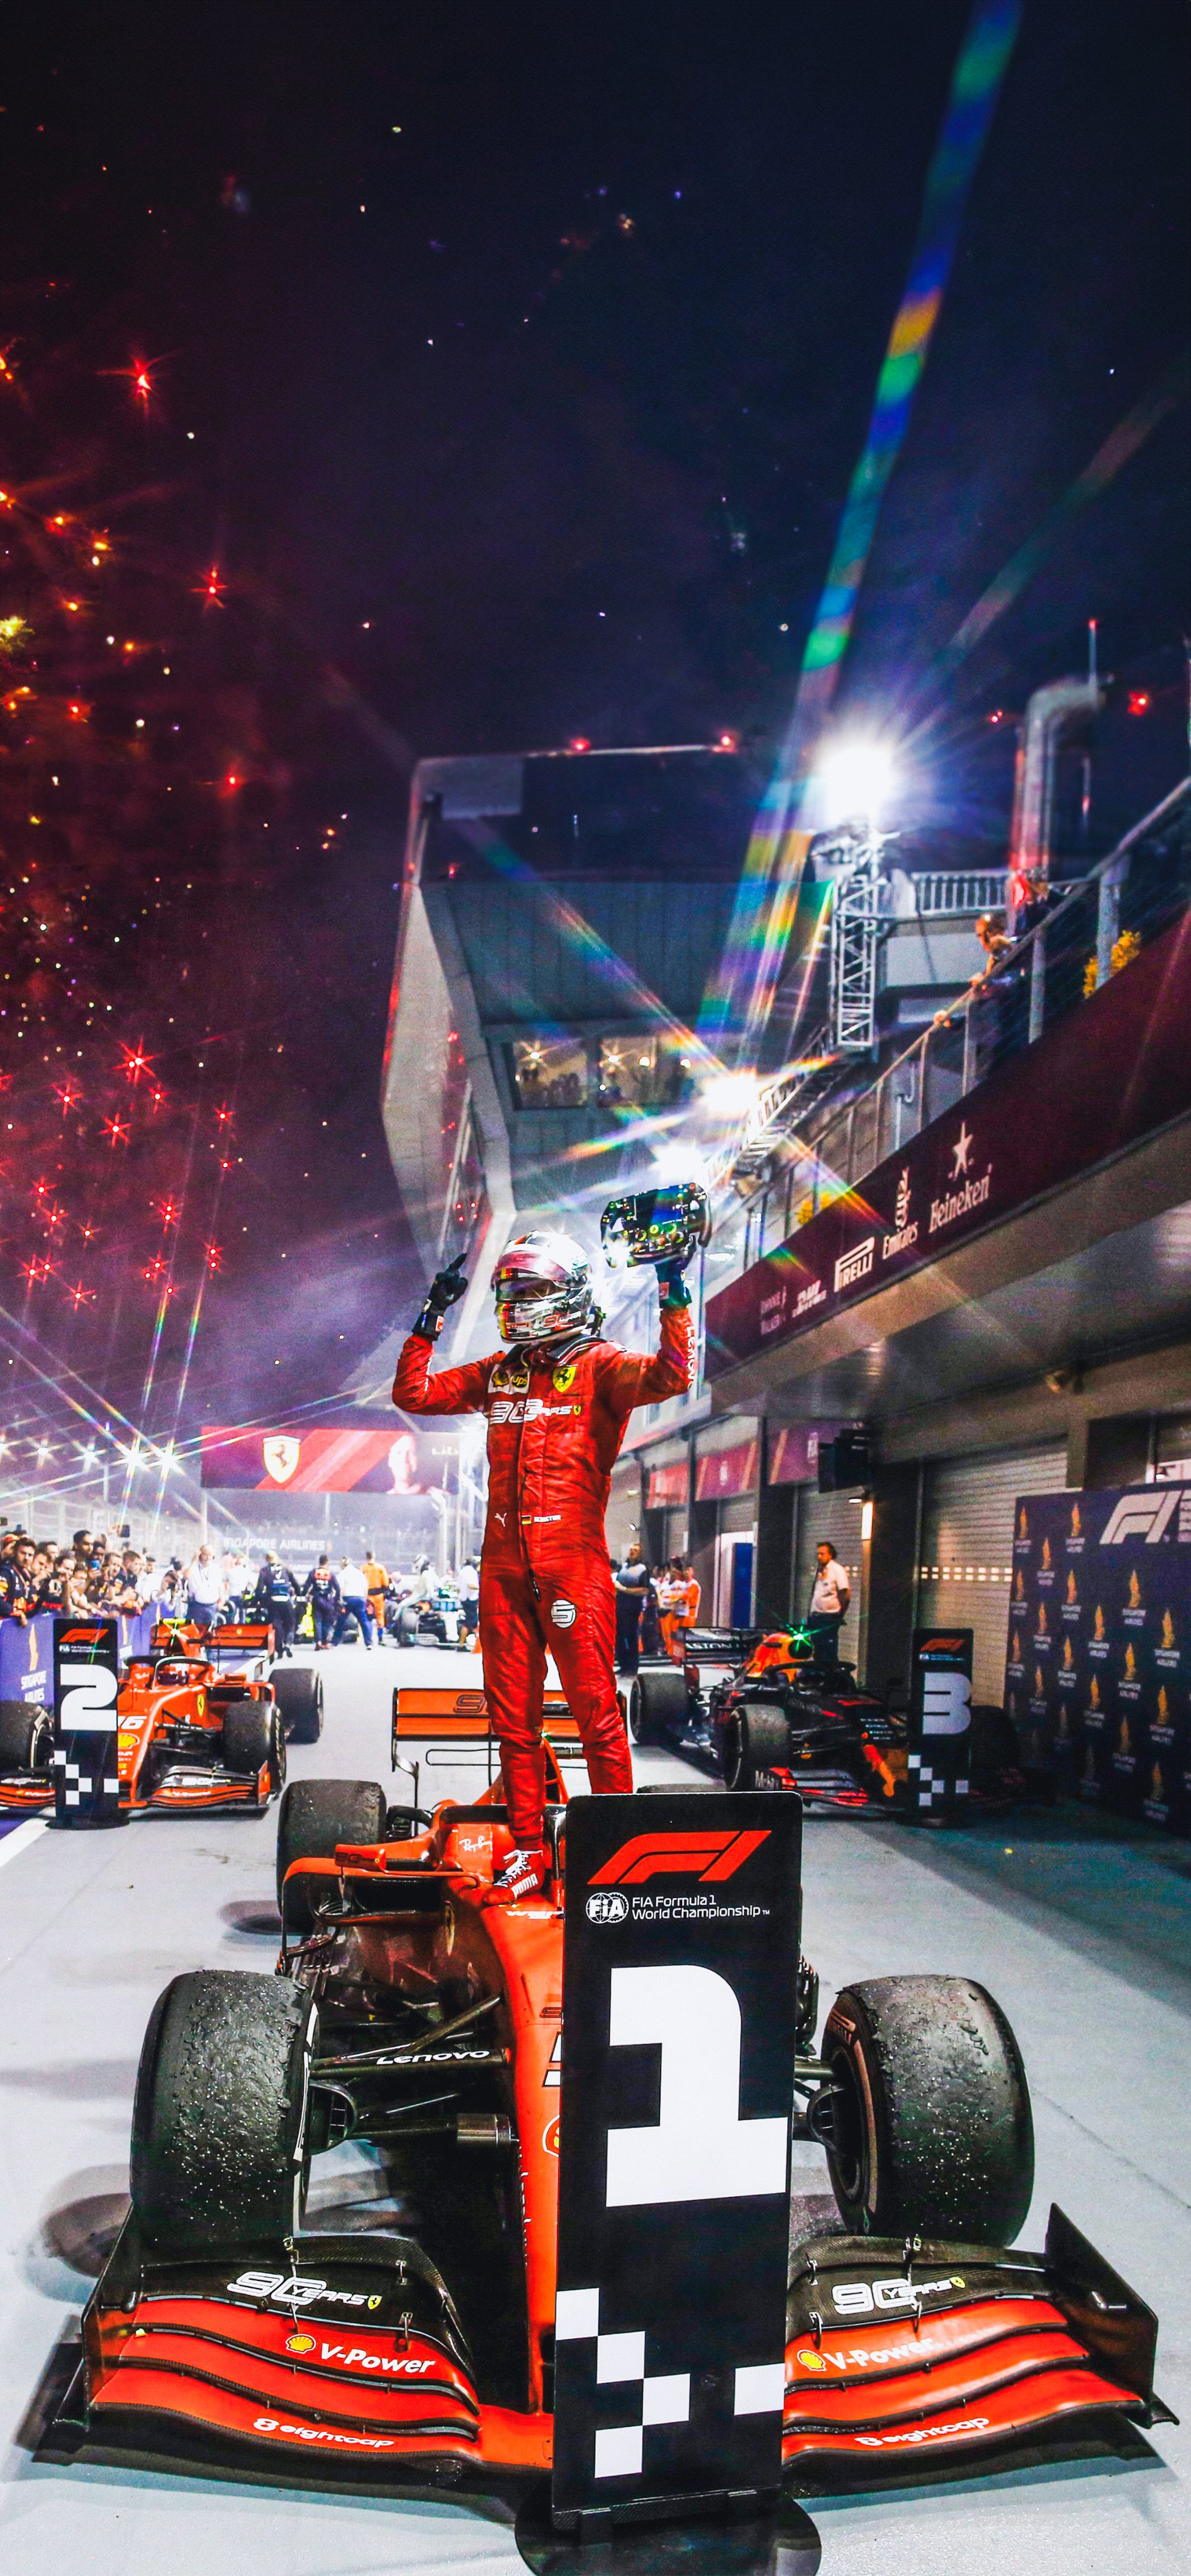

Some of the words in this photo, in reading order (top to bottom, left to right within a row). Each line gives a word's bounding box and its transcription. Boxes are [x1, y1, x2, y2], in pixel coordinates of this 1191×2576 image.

[928, 1175, 990, 1233] Heineken
[834, 1236, 875, 1293] PIRELLI
[552, 1604, 575, 1623] 5
[59, 1628, 109, 1643] F1
[60, 1663, 118, 1731] 2
[922, 1672, 972, 1735] 3
[587, 1829, 773, 1885] F1
[632, 1896, 654, 1908] FIA
[656, 1896, 707, 1907] Formula
[708, 1895, 717, 1906] 1
[632, 1907, 670, 1920] World
[672, 1906, 761, 1919] Championship
[376, 2050, 490, 2065] Lenovo
[605, 1964, 788, 2207] 1
[291, 2285, 369, 2306] YEARS
[883, 2279, 953, 2300] YEARS
[321, 2343, 436, 2373] V-Power
[822, 2338, 934, 2370] V-Power
[882, 2417, 990, 2443] eightcap
